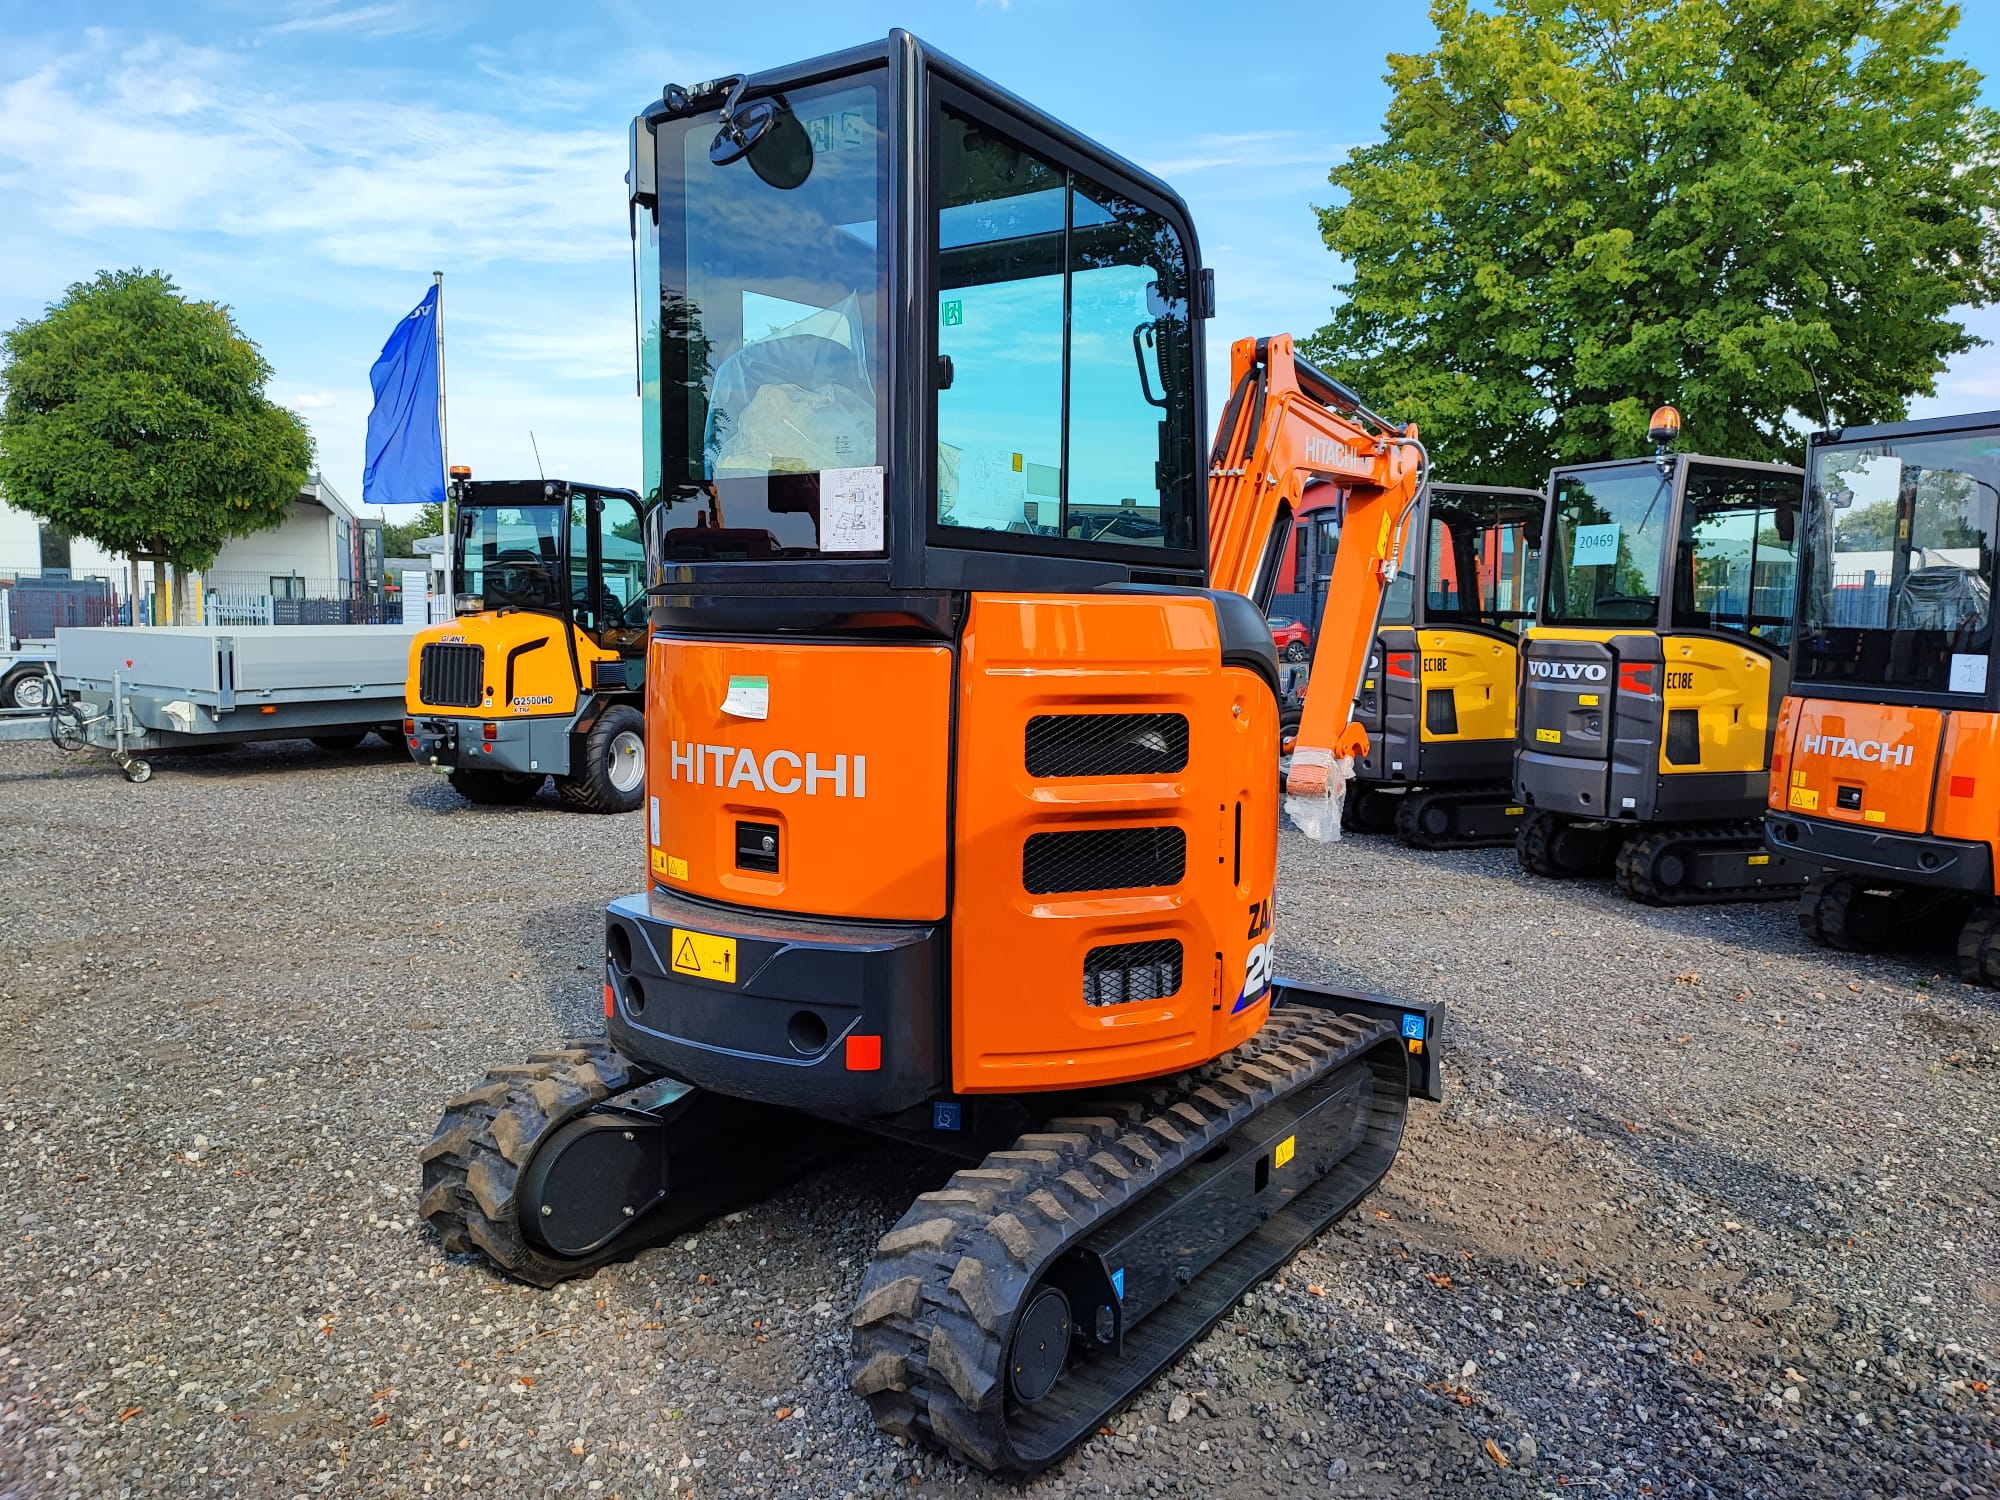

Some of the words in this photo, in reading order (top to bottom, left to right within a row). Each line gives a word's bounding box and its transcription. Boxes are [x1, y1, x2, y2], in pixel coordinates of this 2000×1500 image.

[1305, 436, 1358, 469] HITACHI
[1579, 534, 1614, 548] 20469
[1423, 658, 1447, 672] EC18E
[1528, 661, 1607, 681] VOLVO
[1666, 673, 1693, 689] EC18E
[513, 695, 554, 706] G2500HD
[1803, 734, 1914, 766] HITACHI
[671, 740, 866, 798] HITACHI
